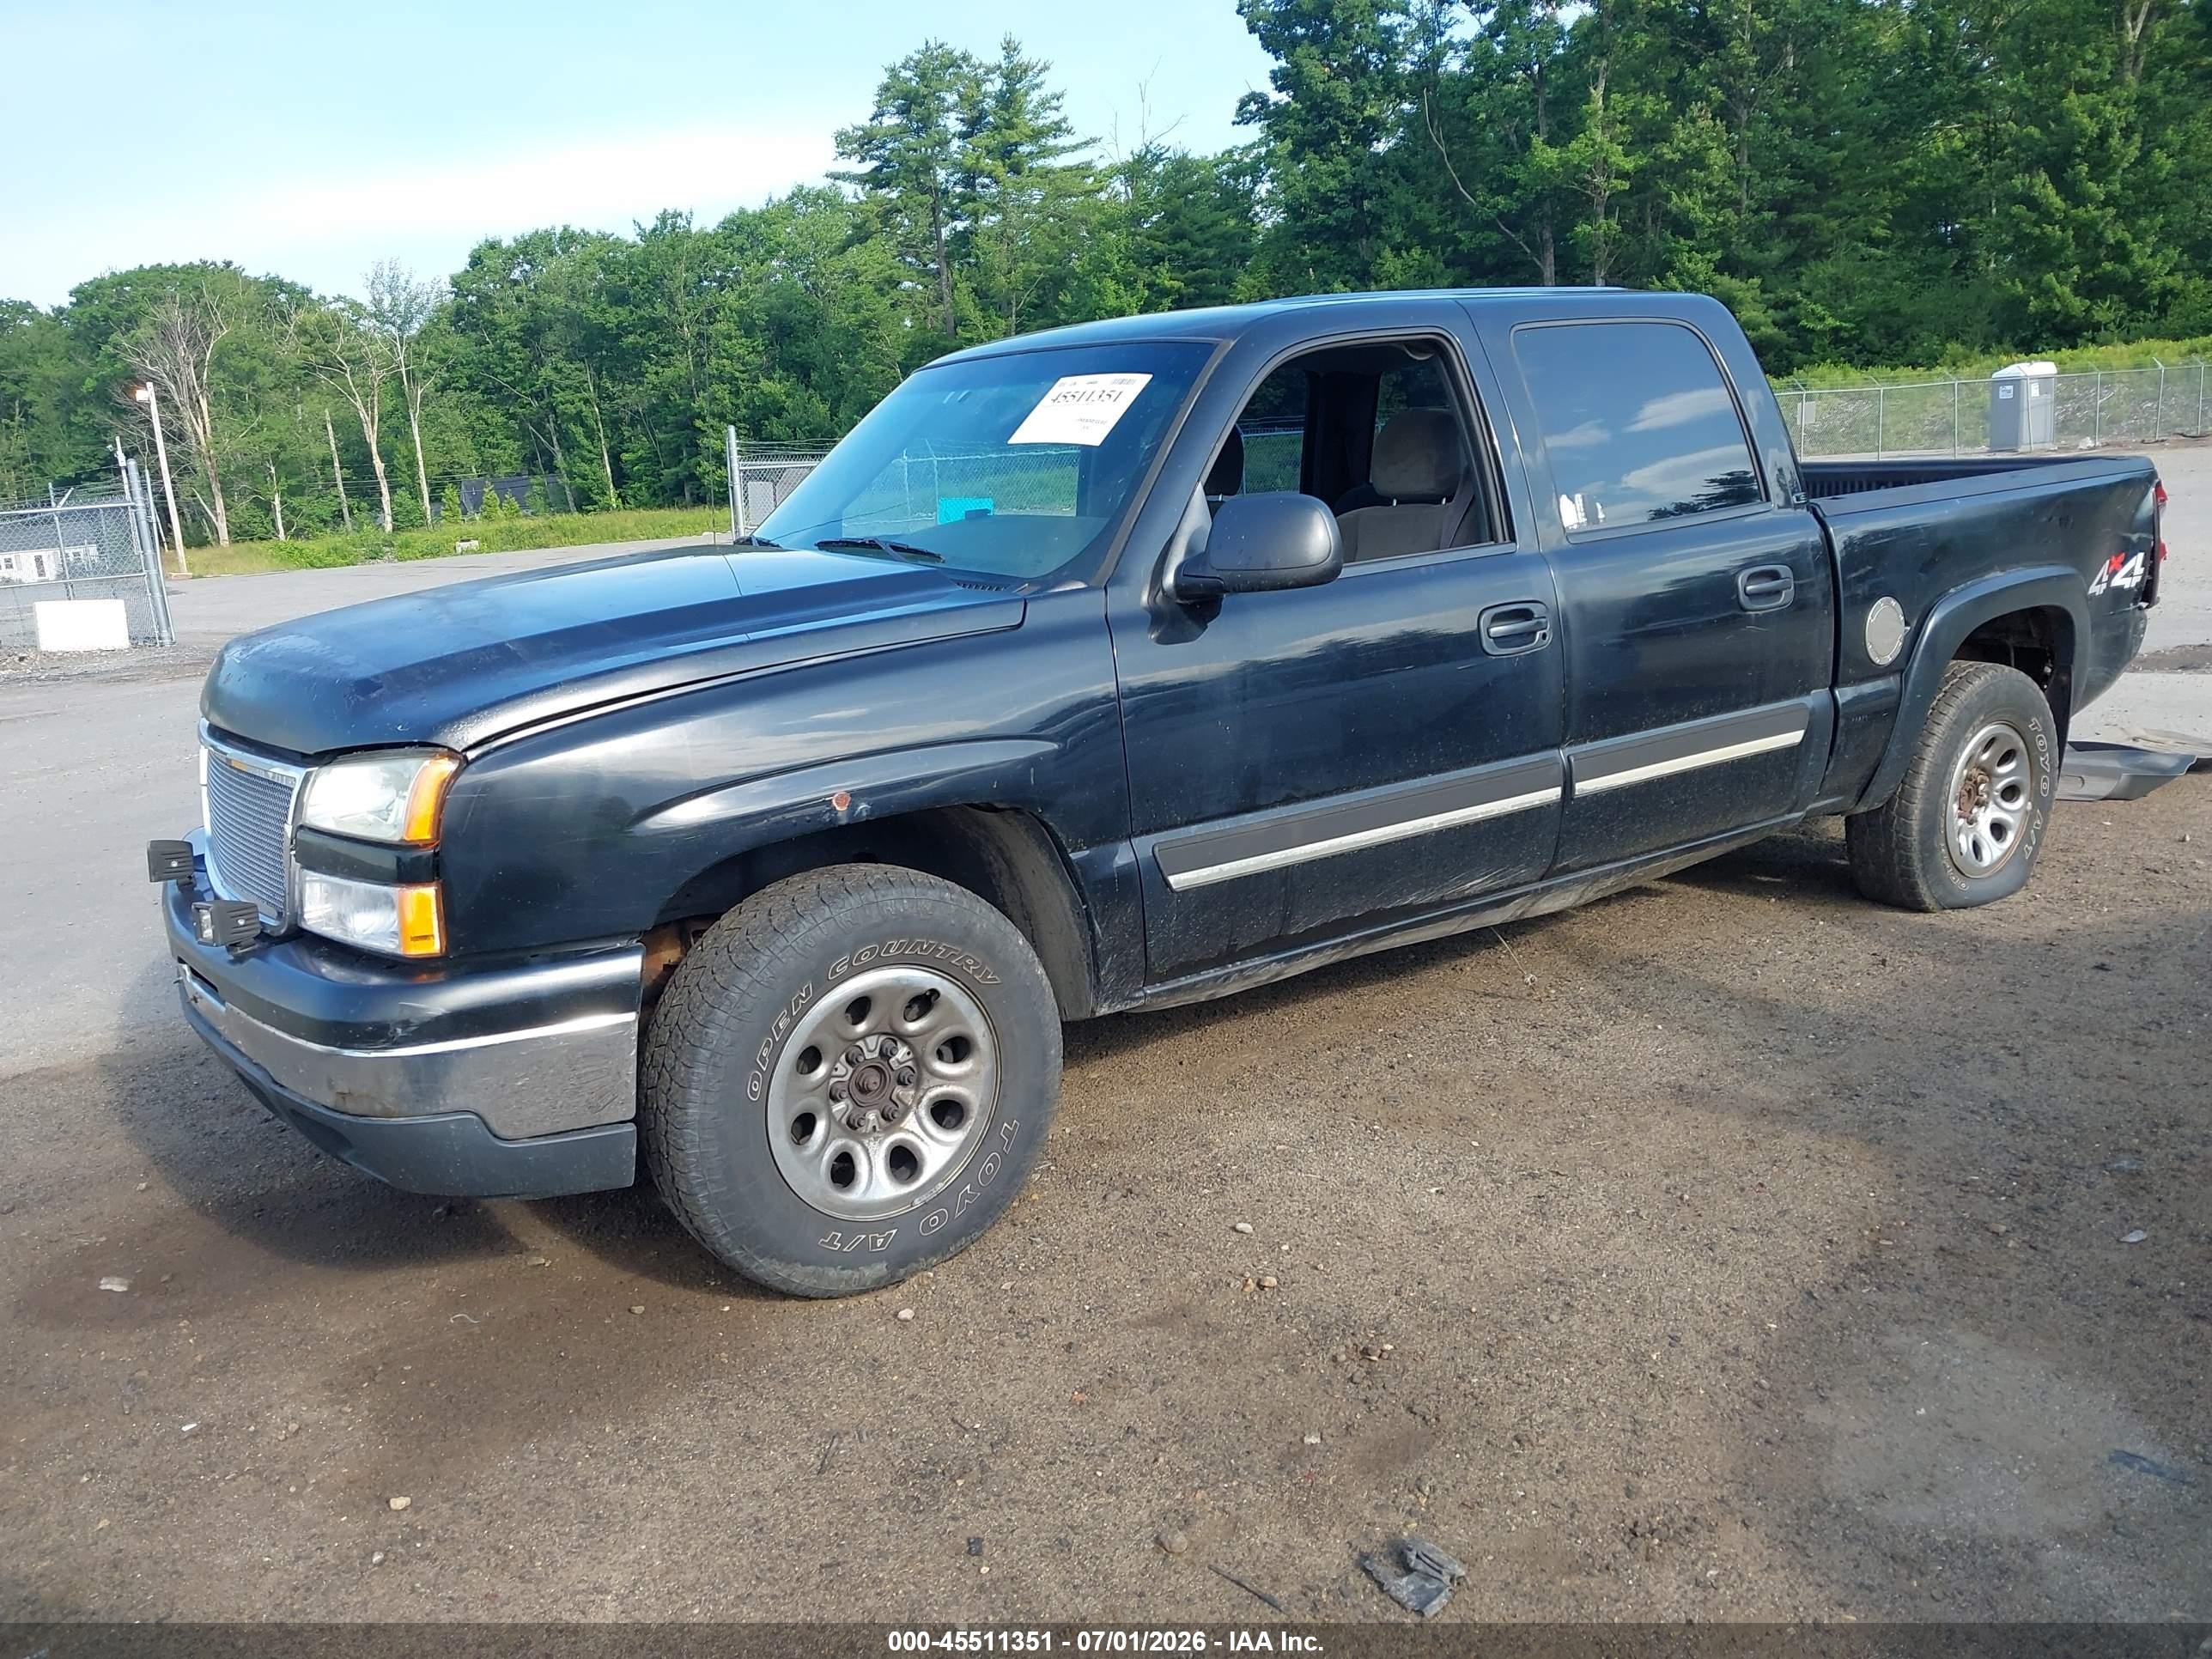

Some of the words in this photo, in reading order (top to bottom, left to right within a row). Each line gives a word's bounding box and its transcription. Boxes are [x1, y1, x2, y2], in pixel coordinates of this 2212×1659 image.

[2028, 718, 2051, 797] TOYO
[747, 982, 812, 1101] OPEN
[828, 939, 1003, 984] COUNTRY
[920, 1120, 1019, 1236] TOYO
[817, 1228, 898, 1252] A/T
